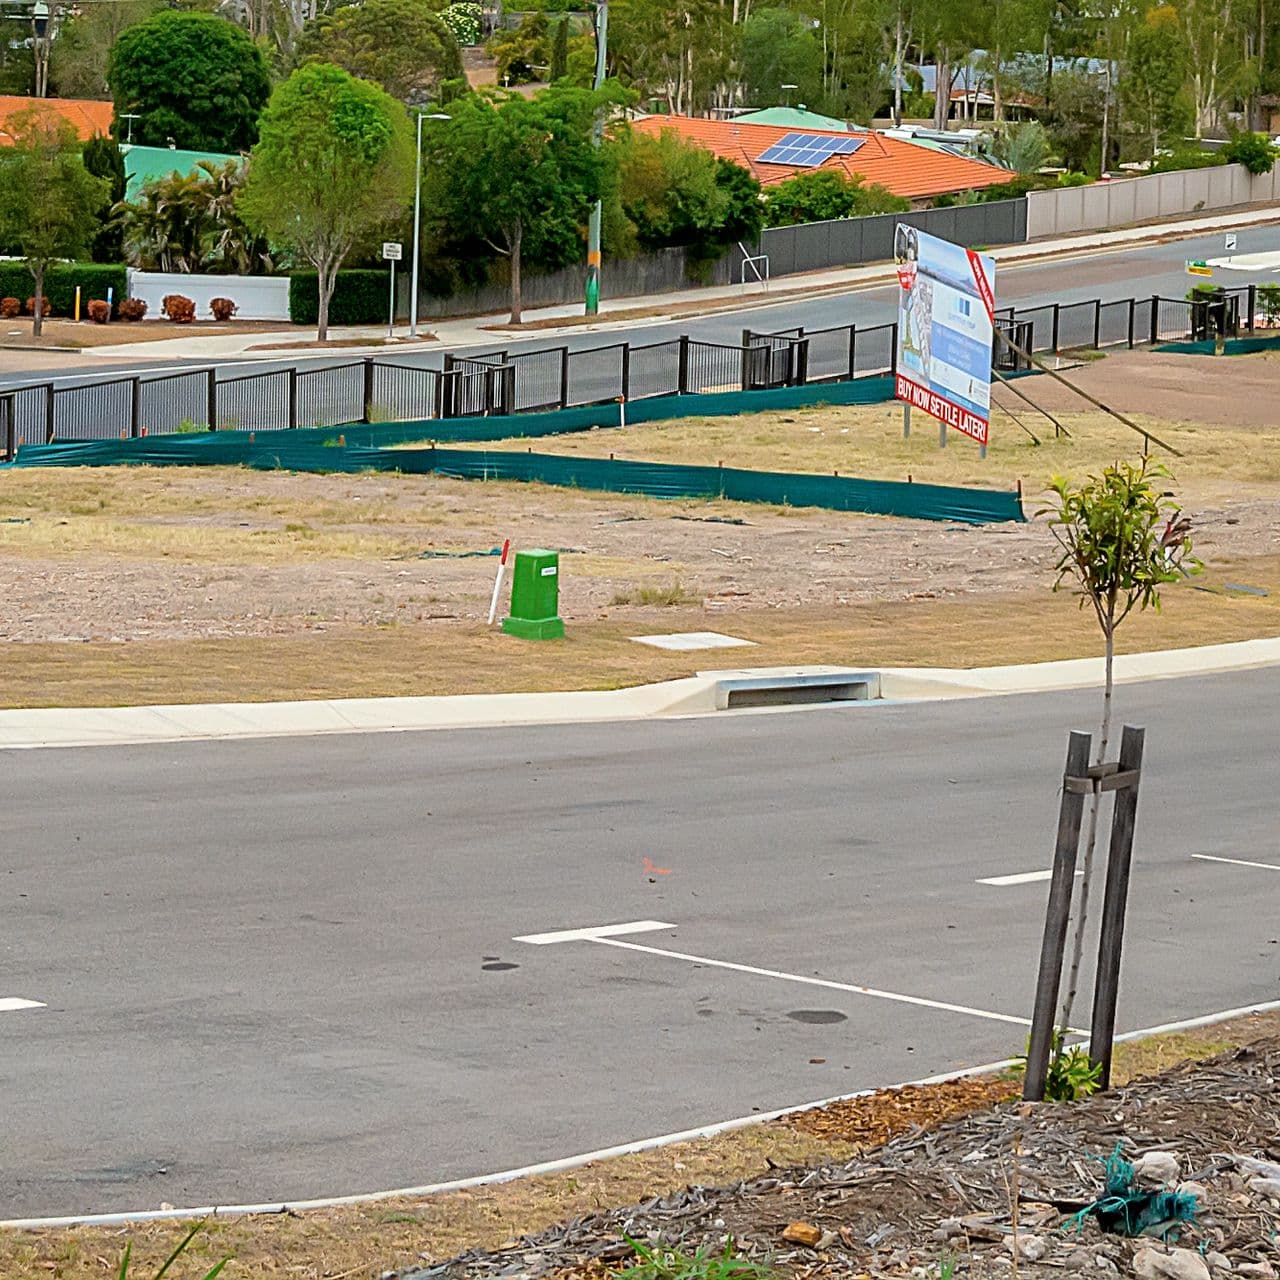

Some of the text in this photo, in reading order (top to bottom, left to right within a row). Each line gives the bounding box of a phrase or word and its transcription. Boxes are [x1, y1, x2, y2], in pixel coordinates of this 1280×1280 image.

[897, 377, 913, 401] BUY
[913, 384, 931, 410] NOW
[930, 395, 958, 426] SETTLE
[959, 409, 987, 441] LATER!
